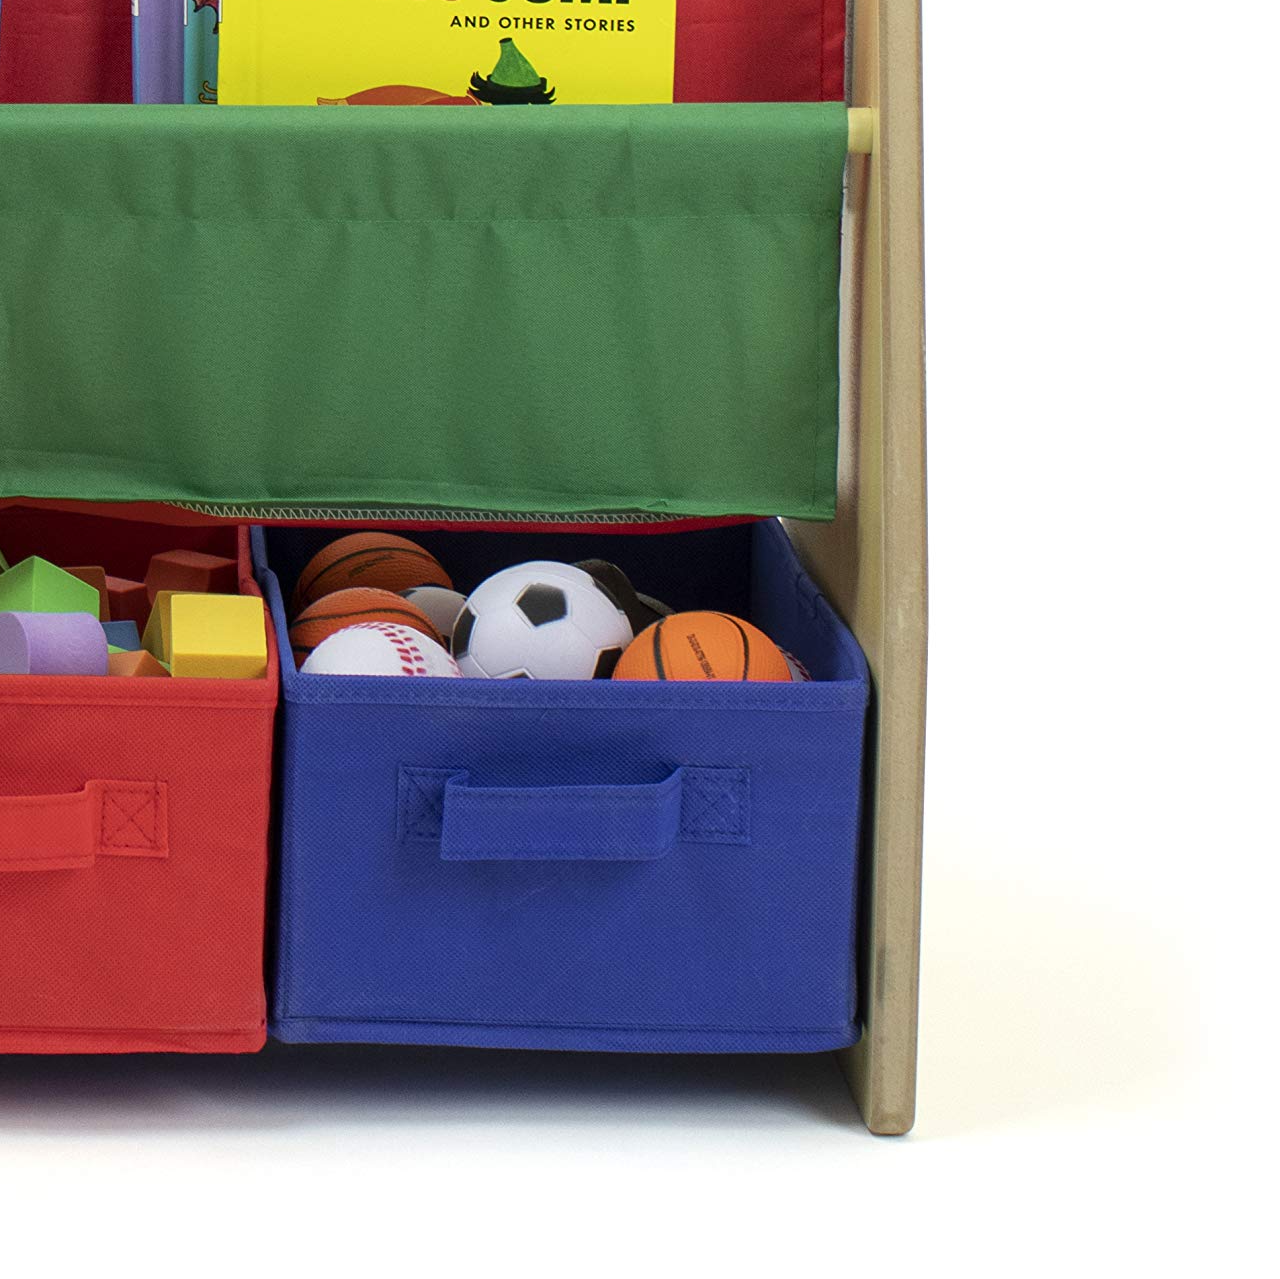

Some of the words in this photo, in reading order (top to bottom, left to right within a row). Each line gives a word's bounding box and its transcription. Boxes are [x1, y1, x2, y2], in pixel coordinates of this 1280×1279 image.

[450, 15, 490, 28] AND
[498, 16, 555, 30] OTHER
[564, 18, 636, 32] STORIES
